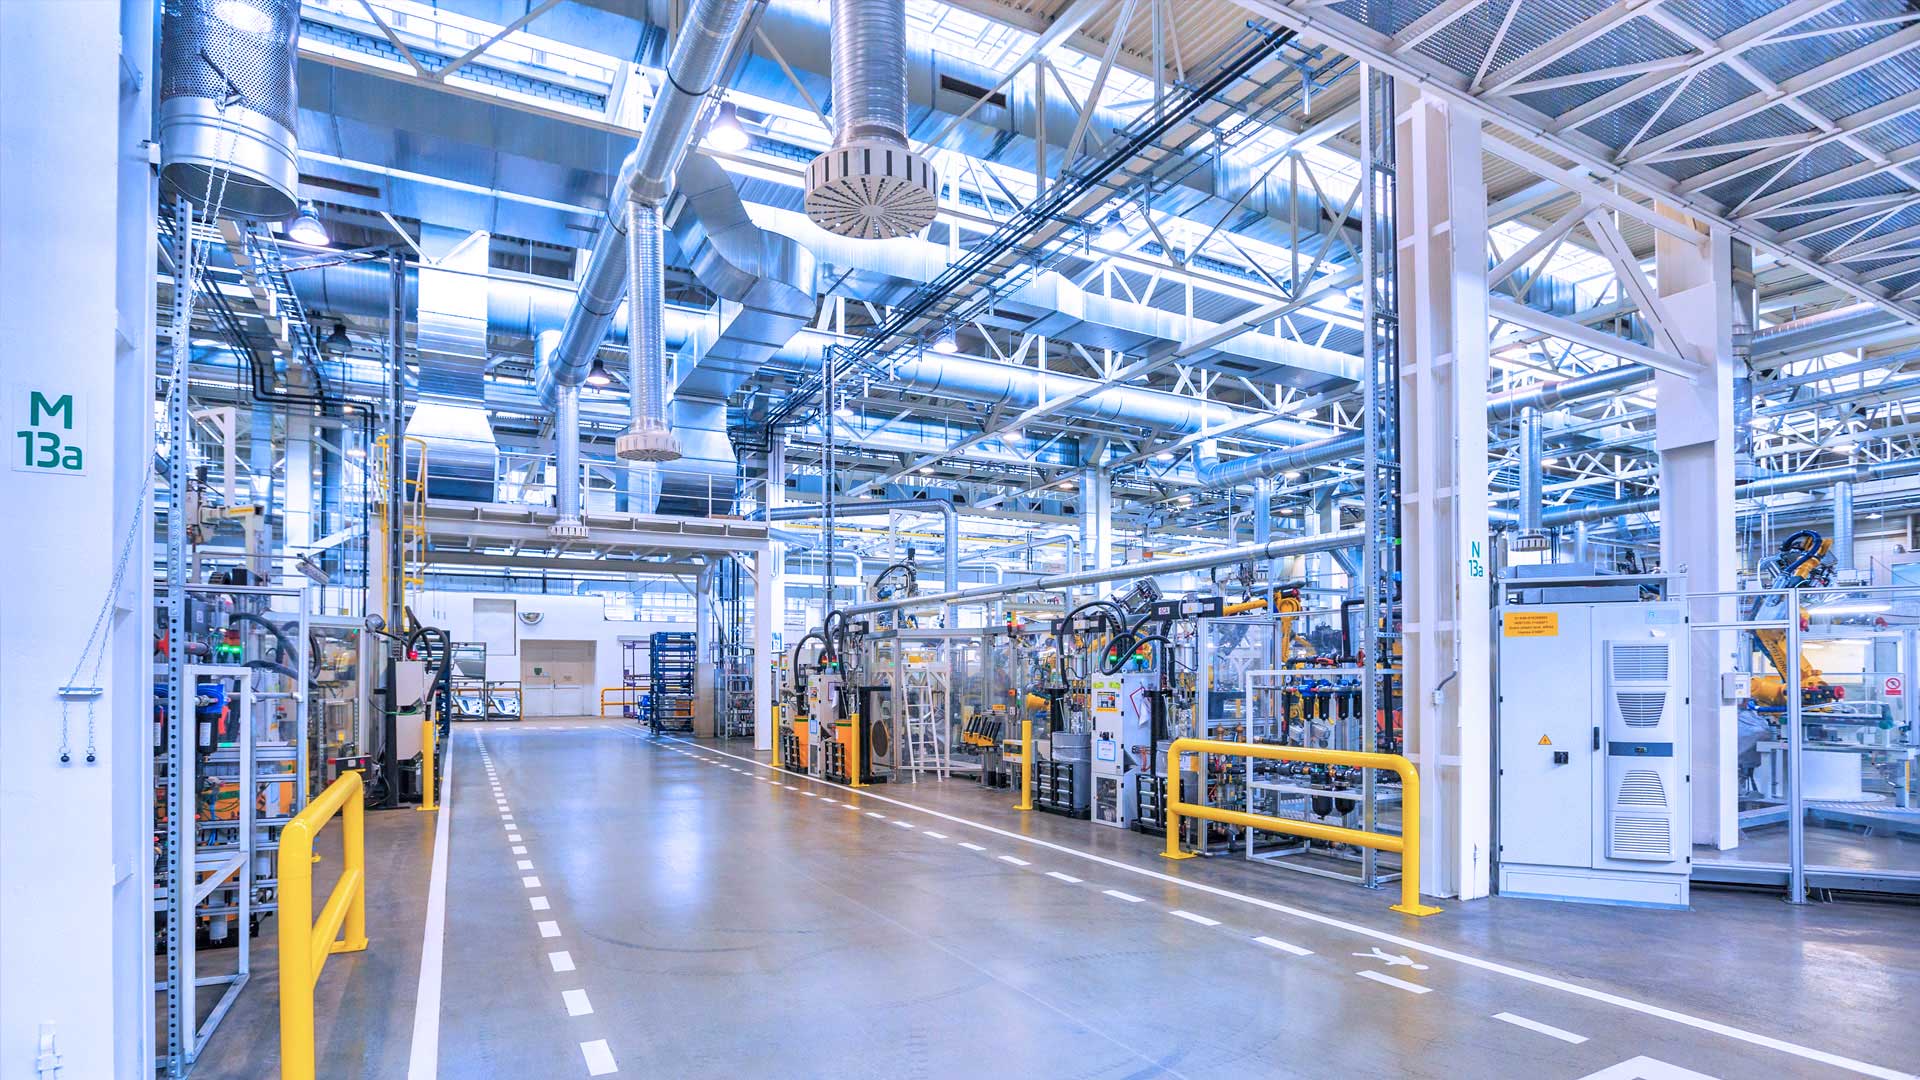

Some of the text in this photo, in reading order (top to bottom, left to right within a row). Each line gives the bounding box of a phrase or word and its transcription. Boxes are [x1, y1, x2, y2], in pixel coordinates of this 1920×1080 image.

[30, 391, 73, 430] M
[16, 430, 83, 470] 13a
[1471, 540, 1480, 558] N
[1468, 559, 1484, 577] 13a
